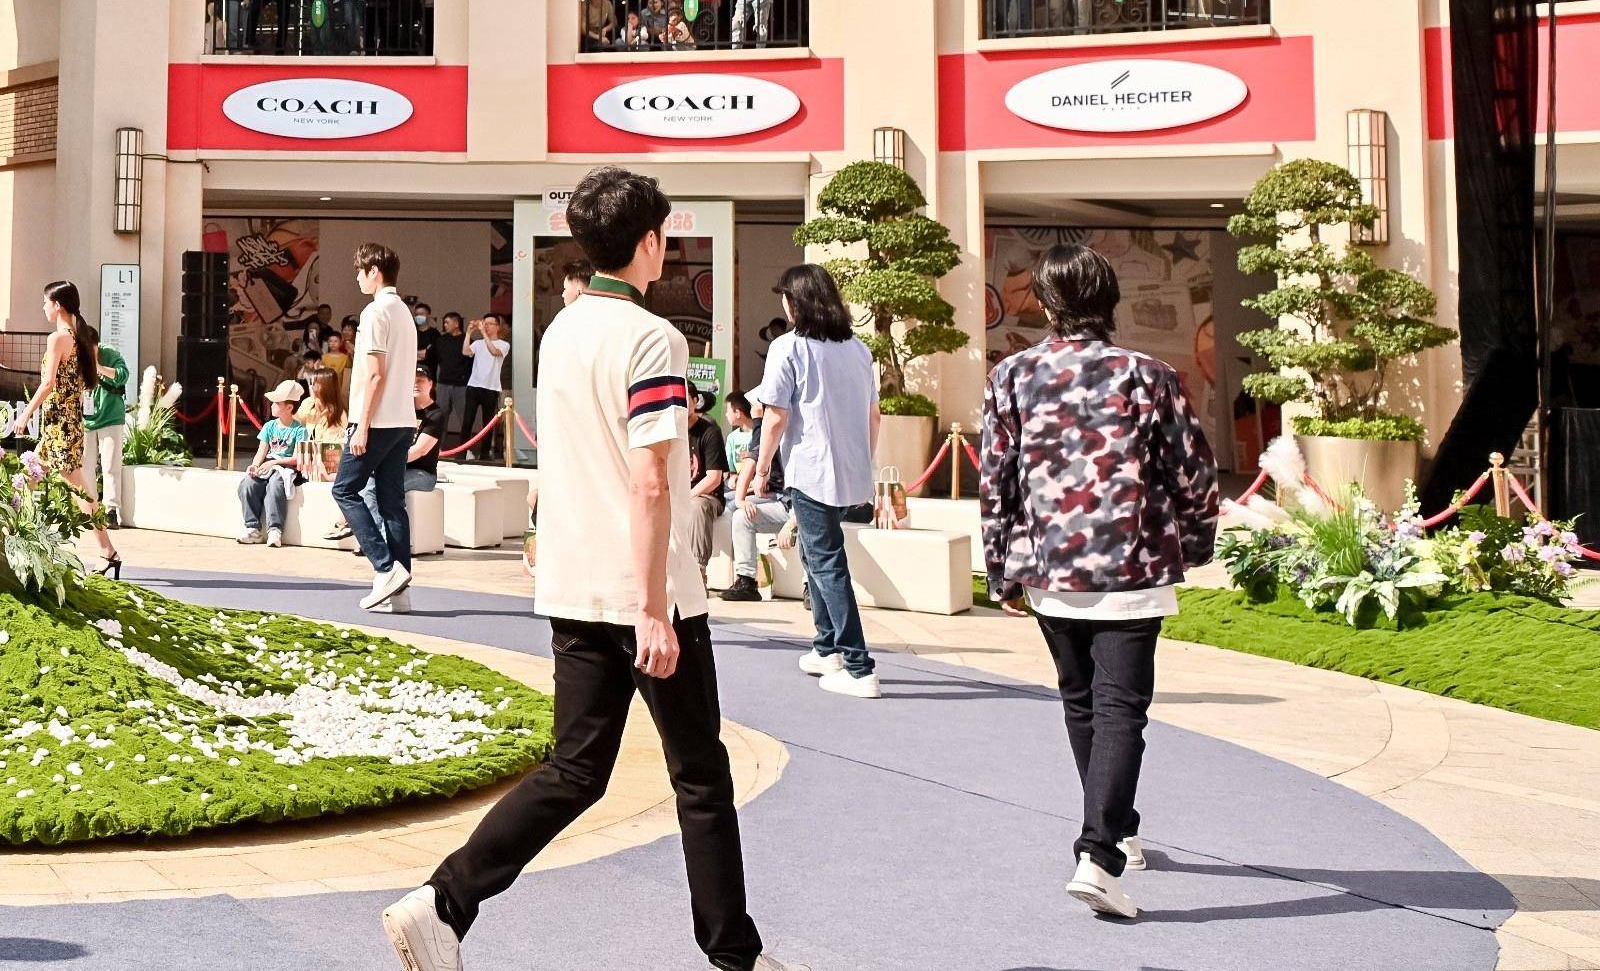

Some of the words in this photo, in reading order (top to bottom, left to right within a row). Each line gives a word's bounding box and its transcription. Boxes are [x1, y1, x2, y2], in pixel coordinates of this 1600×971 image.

[256, 97, 378, 115] COACH
[623, 95, 754, 111] COACH
[1051, 94, 1109, 107] DANIEL
[1115, 90, 1192, 105] HECHTER
[293, 117, 314, 125] NEW
[317, 117, 340, 125] YORK
